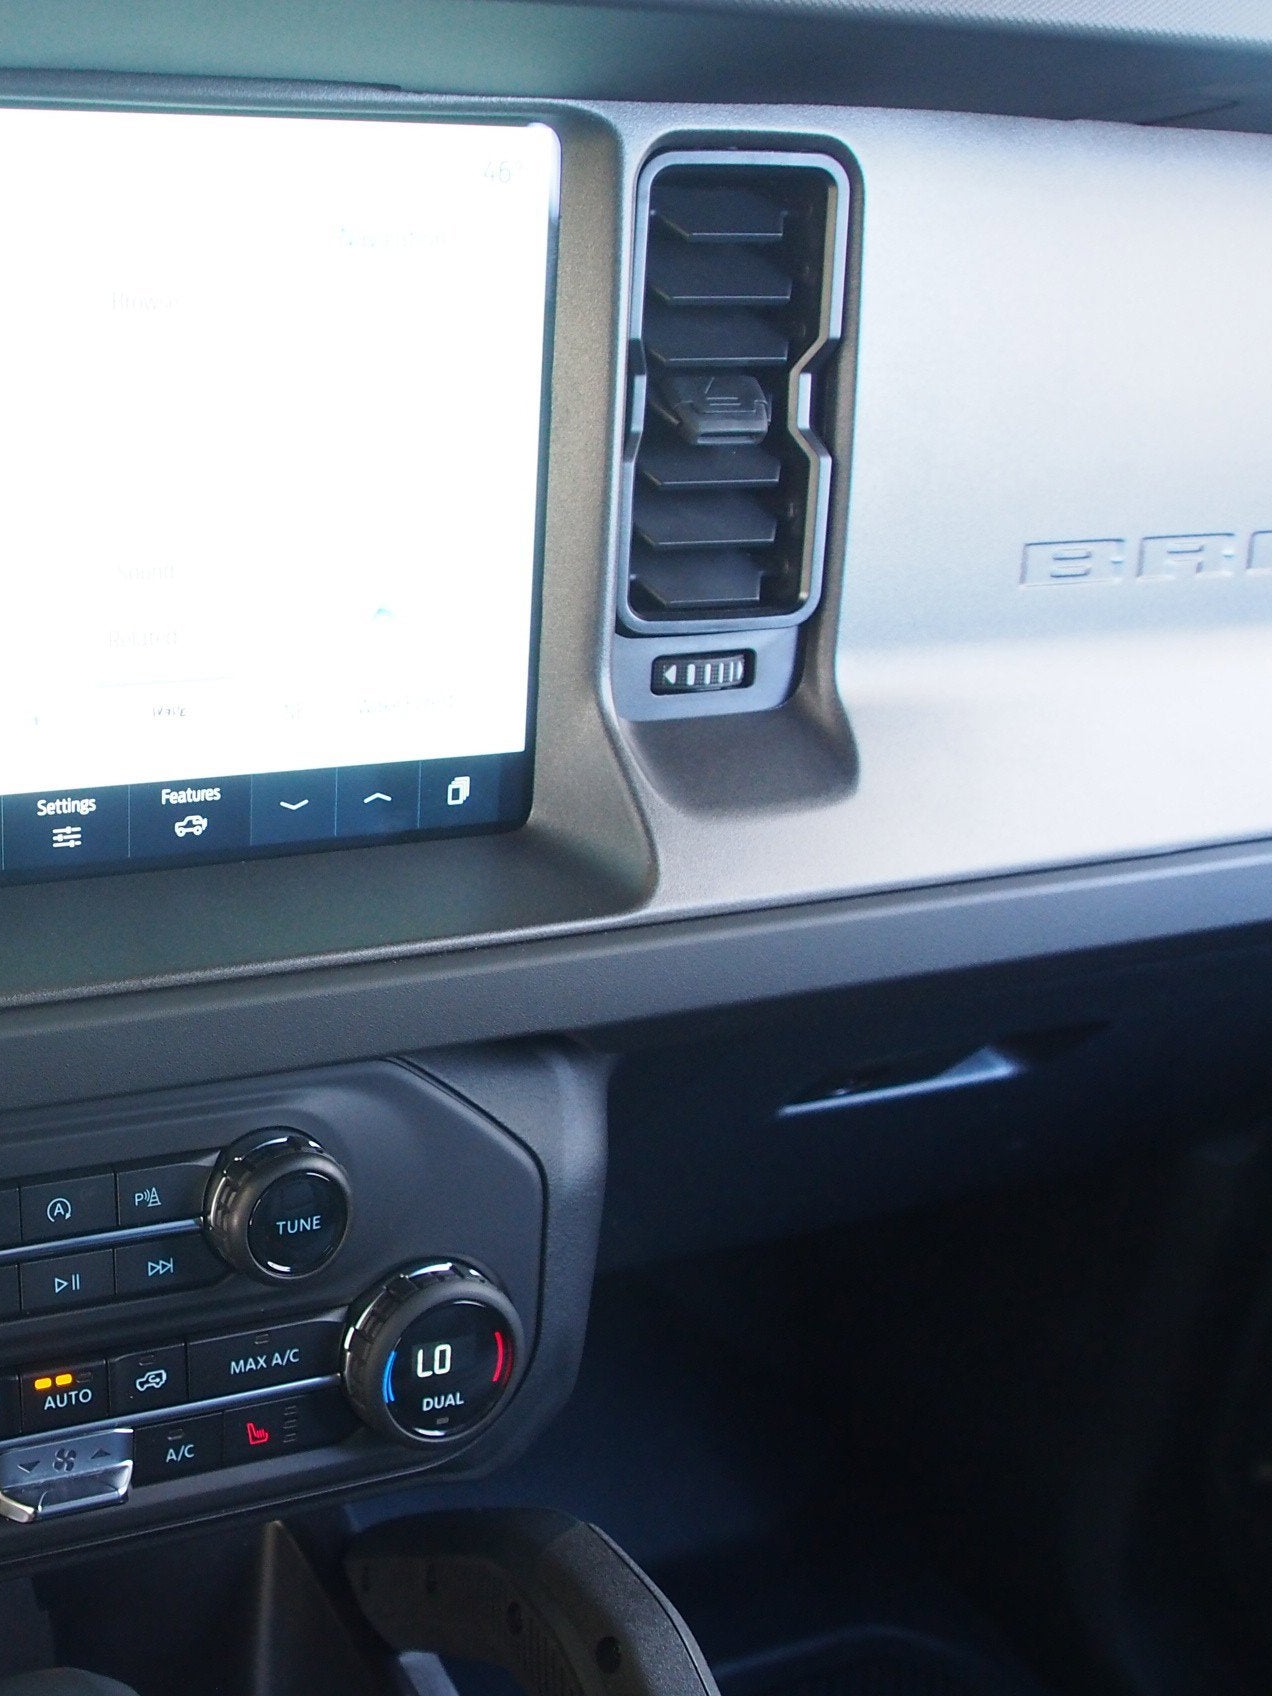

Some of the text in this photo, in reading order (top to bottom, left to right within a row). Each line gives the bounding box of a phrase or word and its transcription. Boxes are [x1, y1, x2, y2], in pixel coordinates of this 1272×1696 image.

[1019, 530, 1272, 588] BR
[36, 795, 97, 817] Settings
[162, 787, 222, 806] Features
[276, 1215, 321, 1236] TUNE
[230, 1348, 300, 1375] MAX A/C
[416, 1343, 452, 1378] LO
[43, 1388, 93, 1411] AUTO
[422, 1392, 466, 1412] DUAL
[166, 1444, 195, 1463] A/C
